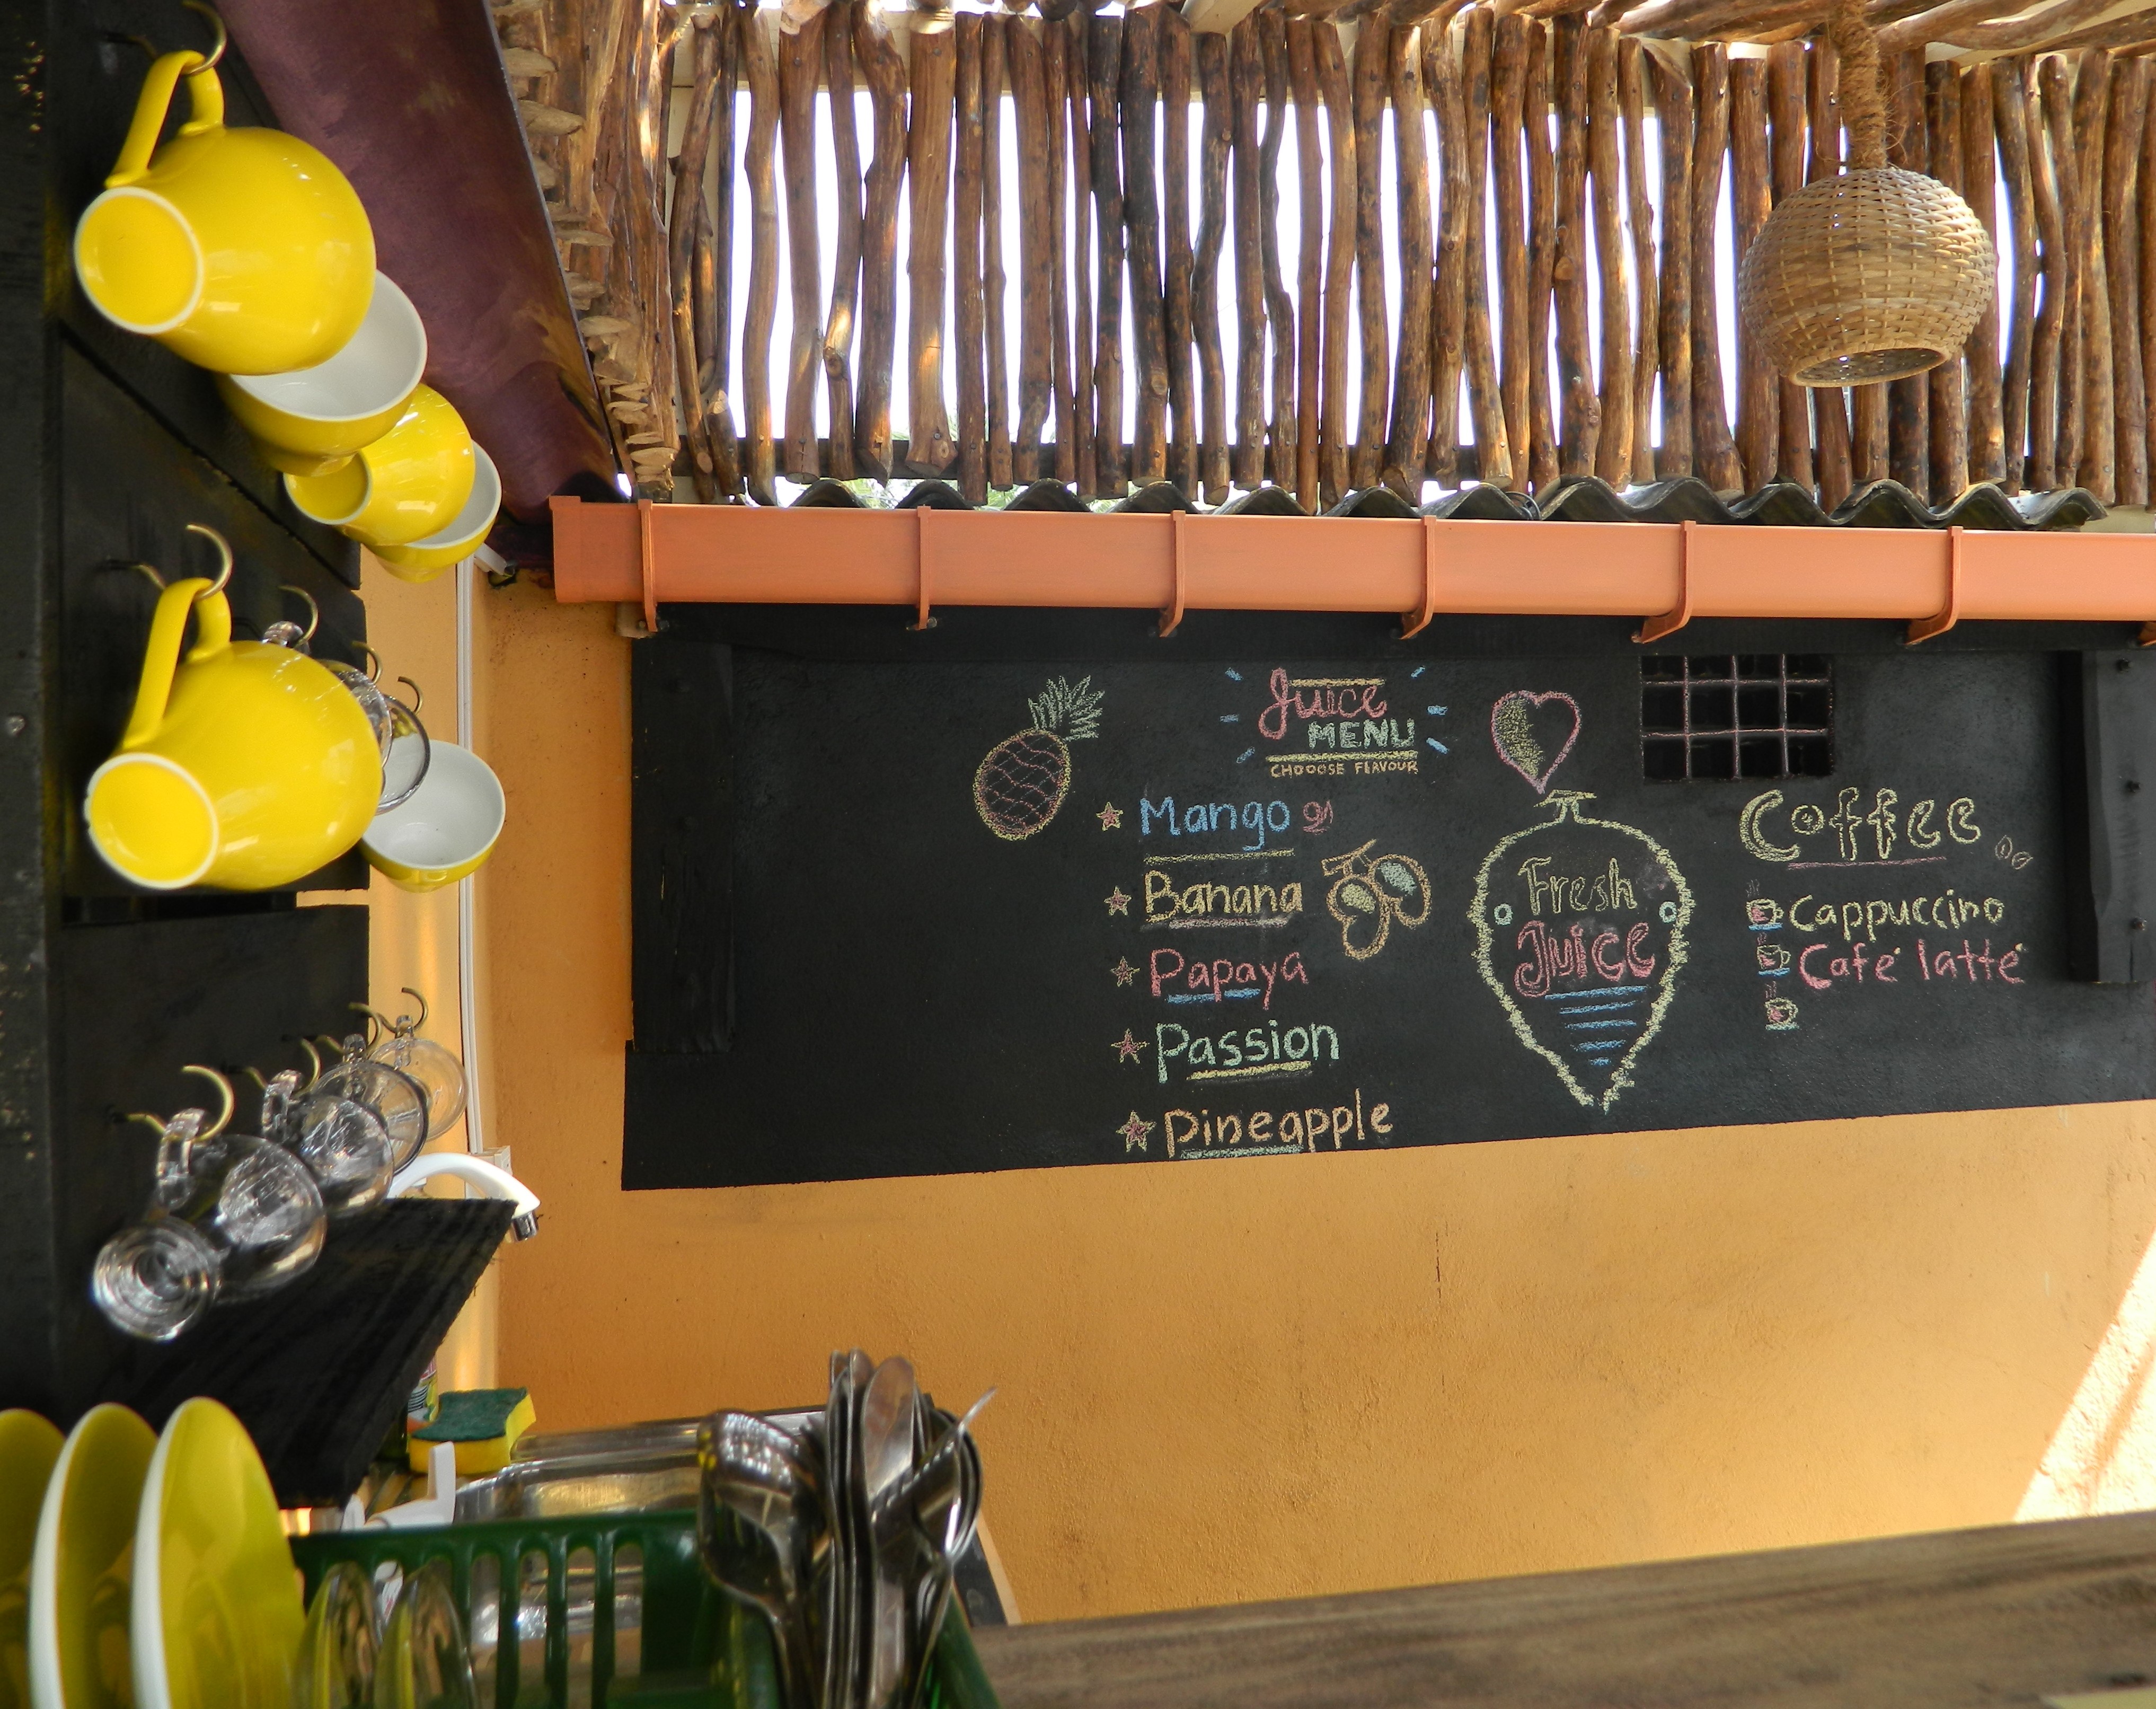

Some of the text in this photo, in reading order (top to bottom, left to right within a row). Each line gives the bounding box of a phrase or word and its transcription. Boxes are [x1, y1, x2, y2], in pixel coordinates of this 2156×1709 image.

[1258, 667, 1388, 740] Juice
[1307, 718, 1415, 749] MENU
[1354, 760, 1419, 774] FLAVOUR
[1139, 796, 1290, 852] Mango
[1740, 787, 1981, 862] Coffee
[1144, 869, 1303, 923] Banana
[1517, 857, 1638, 916] Fresh
[1789, 888, 2004, 942] Cappuccino
[1150, 947, 1309, 1010] Papaya
[1155, 1019, 1340, 1083] Passion
[1164, 1087, 1393, 1159] Pineapple
